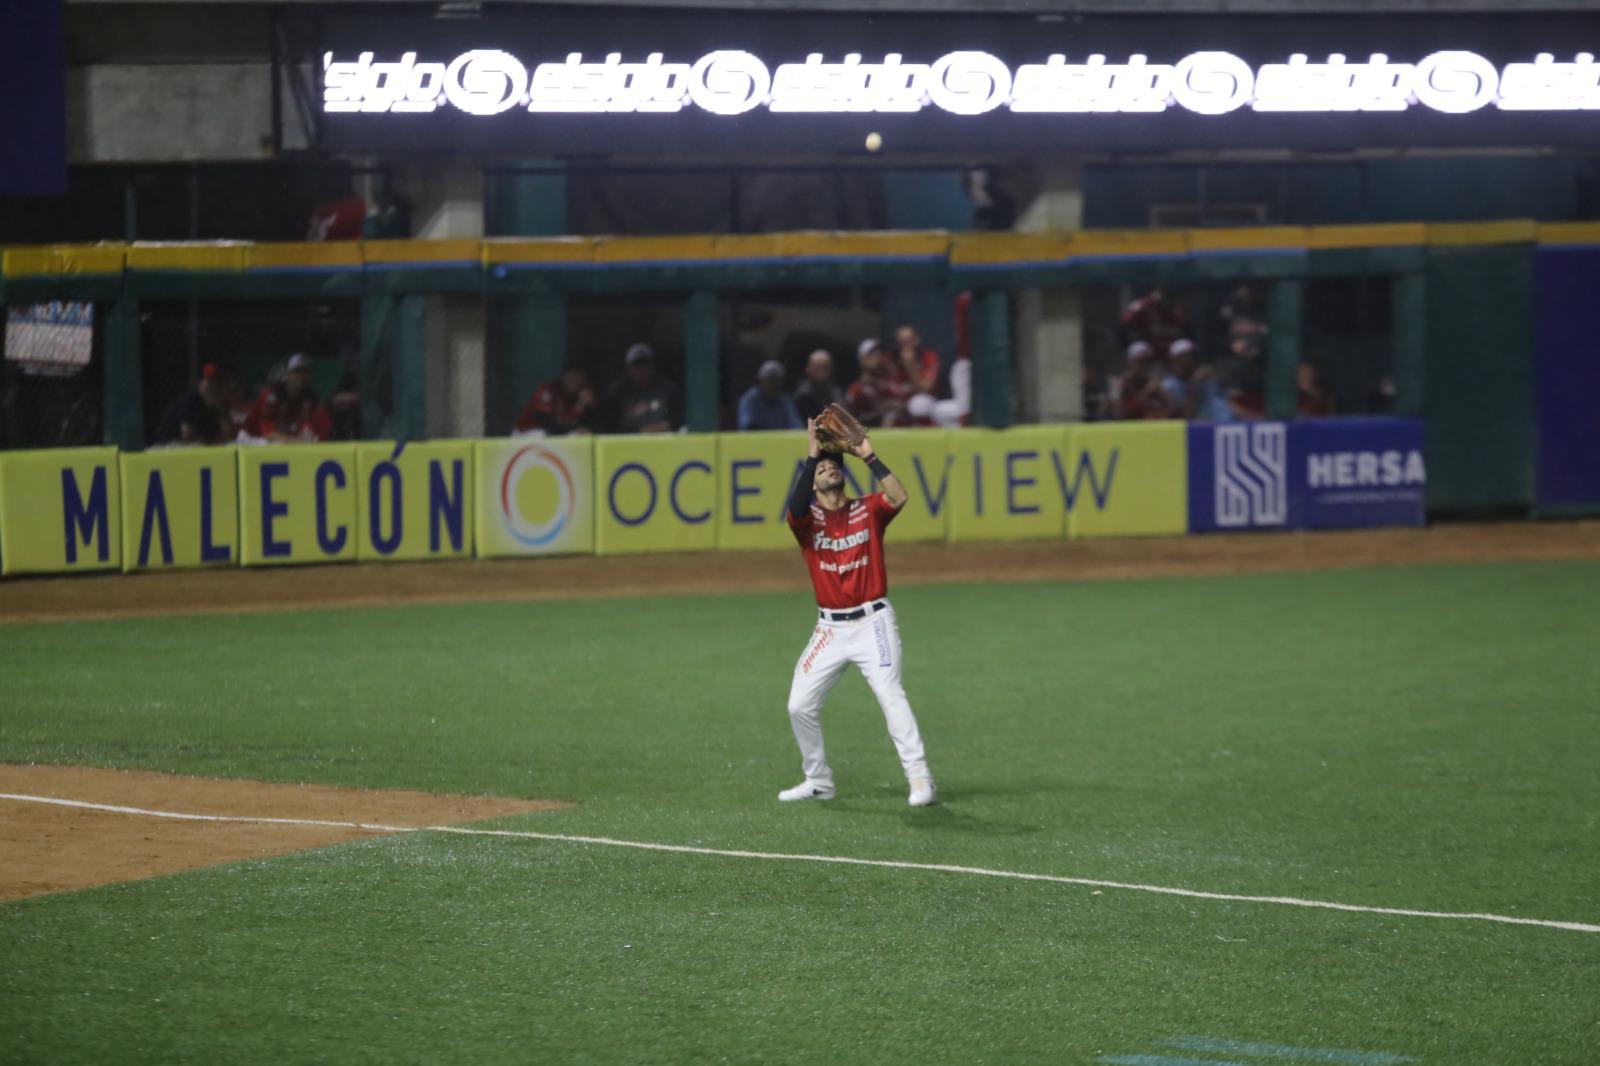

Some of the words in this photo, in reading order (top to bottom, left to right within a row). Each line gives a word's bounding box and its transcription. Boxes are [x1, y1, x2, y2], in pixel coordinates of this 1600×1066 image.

[61, 440, 464, 565] MALECÓN
[913, 448, 1120, 517] VIEW
[1307, 450, 1427, 487] HERSA
